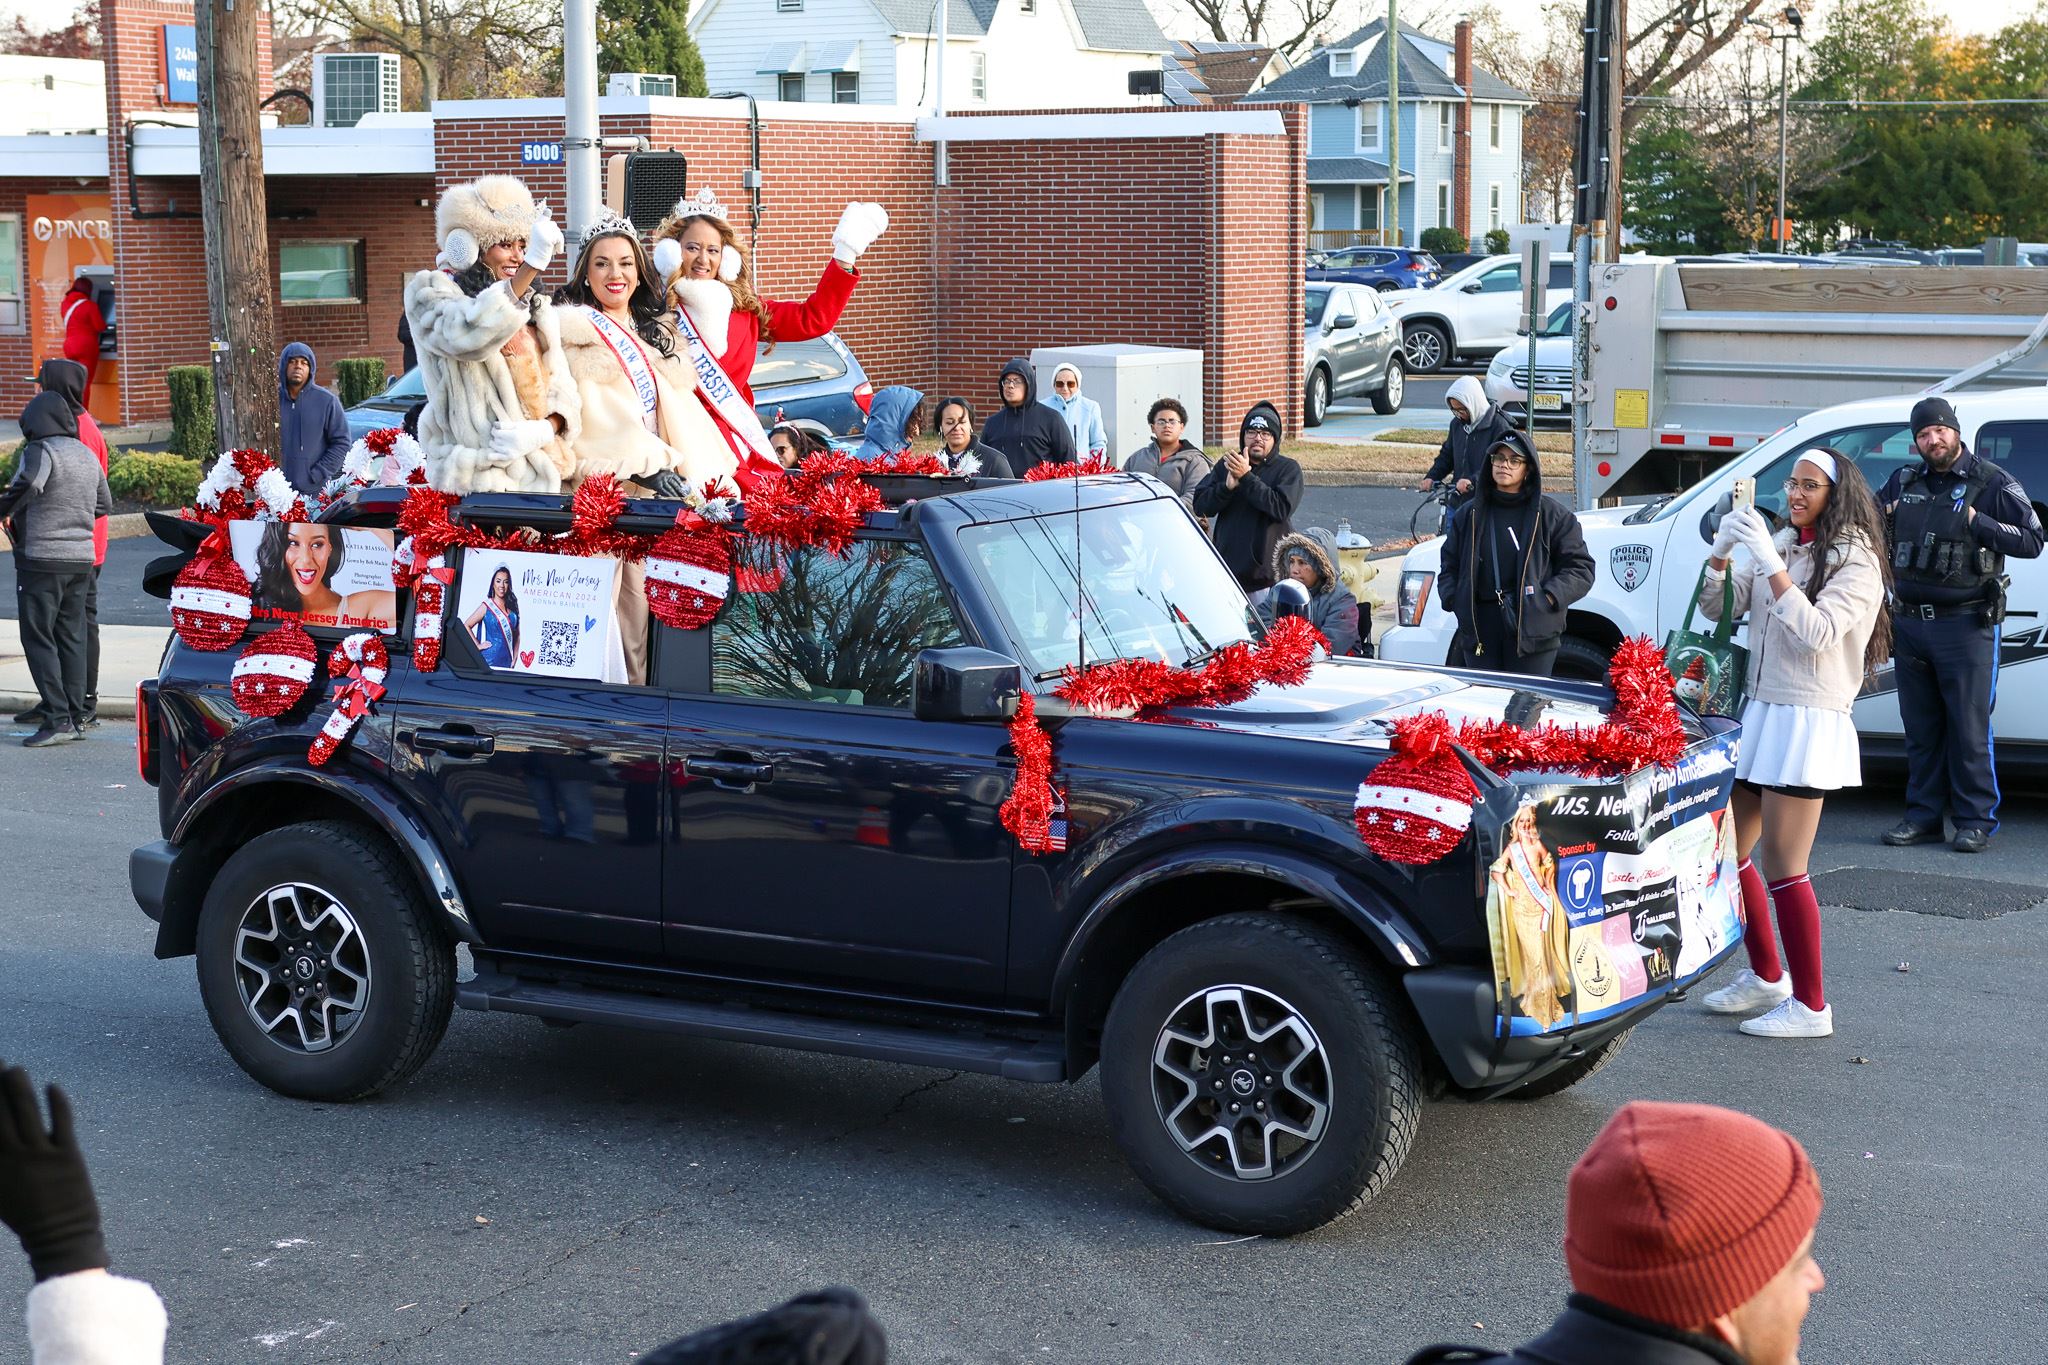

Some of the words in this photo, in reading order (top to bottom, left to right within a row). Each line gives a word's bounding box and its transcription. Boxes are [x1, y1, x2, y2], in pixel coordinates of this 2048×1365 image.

[176, 68, 197, 81] Wal
[524, 144, 559, 161] 5000
[54, 220, 95, 239] PNC
[98, 220, 113, 239] B
[616, 338, 639, 363] NEW
[633, 369, 657, 413] JERSEY
[693, 353, 734, 405] JERSEY
[1615, 546, 1648, 555] POLICE
[1612, 554, 1649, 564] PENNSAUKEN
[354, 572, 382, 580] Photographer
[522, 568, 543, 586] Mrs.
[546, 568, 565, 586] New
[568, 568, 600, 591] Jersey
[1625, 582, 1635, 590] NJ
[524, 588, 572, 599] AMERICAN
[575, 592, 597, 601] 2024
[272, 608, 300, 620] New
[301, 610, 339, 626] Jersey
[341, 614, 389, 629] America
[1551, 796, 1590, 816] MS.
[1557, 843, 1586, 857] Sponsor
[1586, 841, 1596, 852] by
[1607, 872, 1634, 883] Castle
[1646, 911, 1676, 925] GALLERIES
